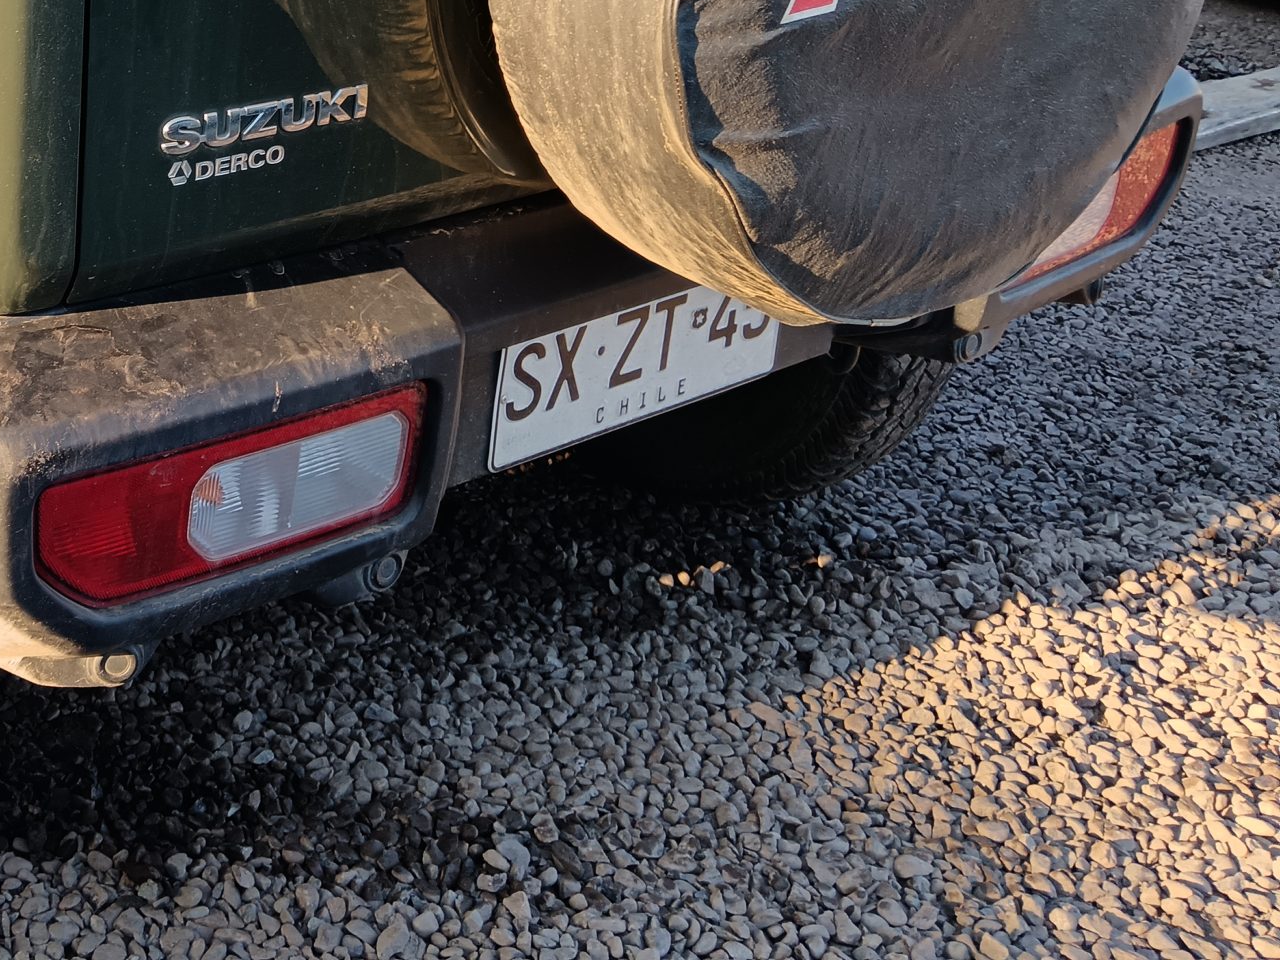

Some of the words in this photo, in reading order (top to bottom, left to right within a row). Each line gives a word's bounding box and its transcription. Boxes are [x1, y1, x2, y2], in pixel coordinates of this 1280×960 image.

[160, 84, 368, 155] SUZUKI
[195, 145, 285, 181] DERCO
[596, 378, 687, 424] CHILE
